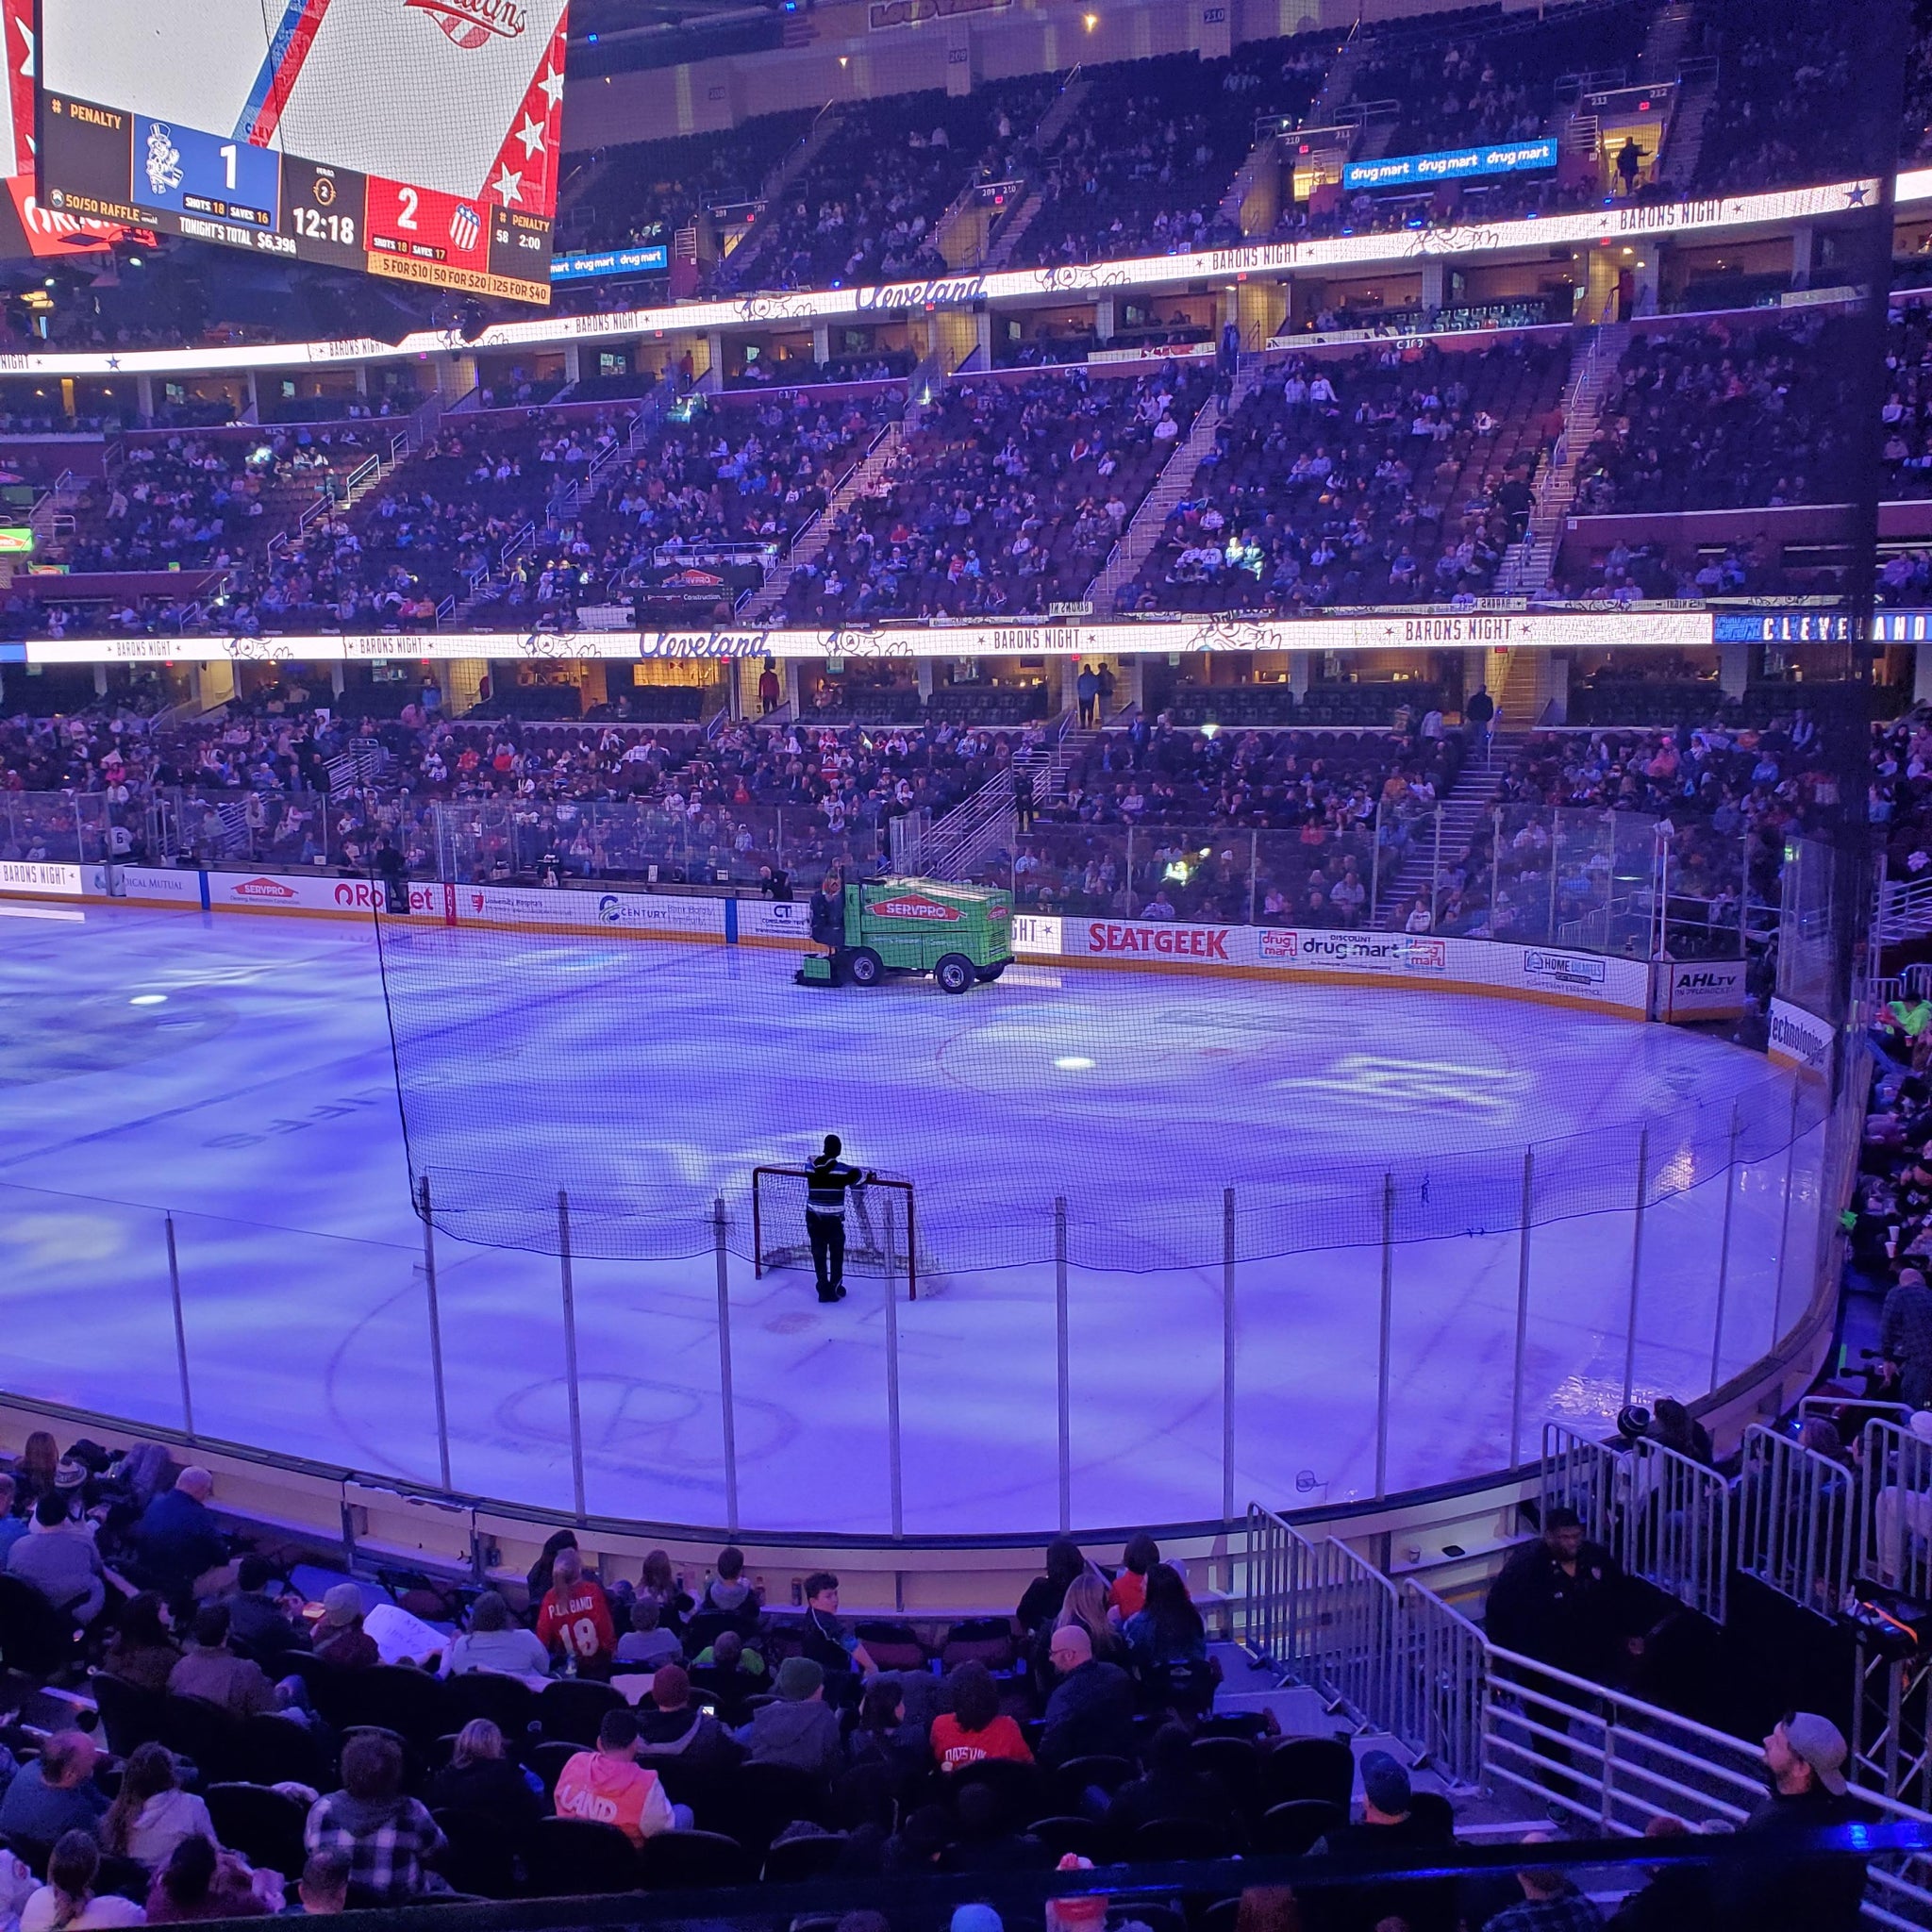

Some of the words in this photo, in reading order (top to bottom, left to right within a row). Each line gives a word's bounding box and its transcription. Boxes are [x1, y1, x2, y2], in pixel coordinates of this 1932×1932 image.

[1206, 10, 1224, 21] 210
[70, 103, 122, 129] PENALTY
[1418, 159, 1445, 174] drug
[1448, 155, 1477, 168] mart
[1487, 151, 1515, 165] drug
[1518, 146, 1549, 160] mart
[220, 144, 237, 190] 1
[1351, 168, 1377, 181] drug
[1380, 164, 1408, 176] mart
[65, 194, 97, 212] 50/50
[100, 202, 140, 222] RAFFLE
[185, 196, 211, 211] SHOTS
[212, 202, 225, 214] 18
[397, 188, 418, 230] 2
[1620, 202, 1675, 230] BARONS
[1681, 199, 1725, 224] NIGHT
[229, 208, 255, 221] SAVES
[257, 211, 269, 225] 16
[293, 208, 354, 244] 12:18
[512, 214, 550, 233] PENALTY
[179, 216, 225, 241] TONIGHT'S
[226, 226, 253, 246] TOTAL
[496, 229, 508, 243] 58
[519, 234, 541, 250] 2:00
[374, 237, 396, 250] SHOTS
[412, 246, 433, 258] SAVES
[435, 249, 445, 260] 17
[575, 261, 594, 271] drug
[595, 257, 615, 268] mart
[620, 255, 640, 265] drug
[641, 251, 661, 262] mart
[1212, 248, 1258, 270] BARONS
[1263, 243, 1299, 265] NIGHT
[551, 262, 569, 273] mart
[383, 258, 390, 271] 5
[391, 262, 409, 275] FOR
[411, 265, 428, 279] $10
[448, 271, 467, 286] FOR
[468, 274, 486, 289] $20
[493, 280, 508, 292] 125
[509, 284, 527, 297] FOR
[529, 286, 546, 300] $40
[856, 275, 988, 310] Cleveland
[575, 315, 610, 333] BARONS
[614, 312, 640, 329] NIGHT
[329, 341, 358, 357] BARONS
[2, 355, 29, 369] NIGHT
[1407, 621, 1460, 641] BARONS
[1468, 619, 1512, 640] NIGHT
[1762, 617, 1924, 641] CLEVELAND
[360, 638, 393, 654] BARONS
[397, 637, 423, 654] NIGHT
[640, 633, 771, 658] Cleveland
[994, 630, 1039, 649] BARONS
[1044, 629, 1079, 648] NIGHT
[117, 641, 145, 657] BARONS
[149, 641, 171, 657] NIGHT
[116, 832, 124, 844] 6
[4, 865, 37, 883] BARONS
[40, 866, 65, 885] NIGHT
[149, 879, 182, 890] MUTUAL
[245, 885, 284, 895] SERVPRO
[356, 884, 434, 910] Roet
[621, 908, 667, 919] CENTURY
[774, 906, 791, 918] CT
[886, 903, 947, 918] SERVPRO
[1090, 924, 1229, 959] SEATGEEK
[1262, 931, 1291, 946] drug
[1330, 934, 1372, 942] DISCOUNT
[1265, 946, 1297, 956] mart
[1303, 938, 1349, 959] drug
[1353, 942, 1400, 958] mart
[1411, 955, 1444, 966] mart
[1545, 958, 1570, 972] HOME
[558, 1618, 599, 1657] 18
[560, 1784, 618, 1823] LAND
